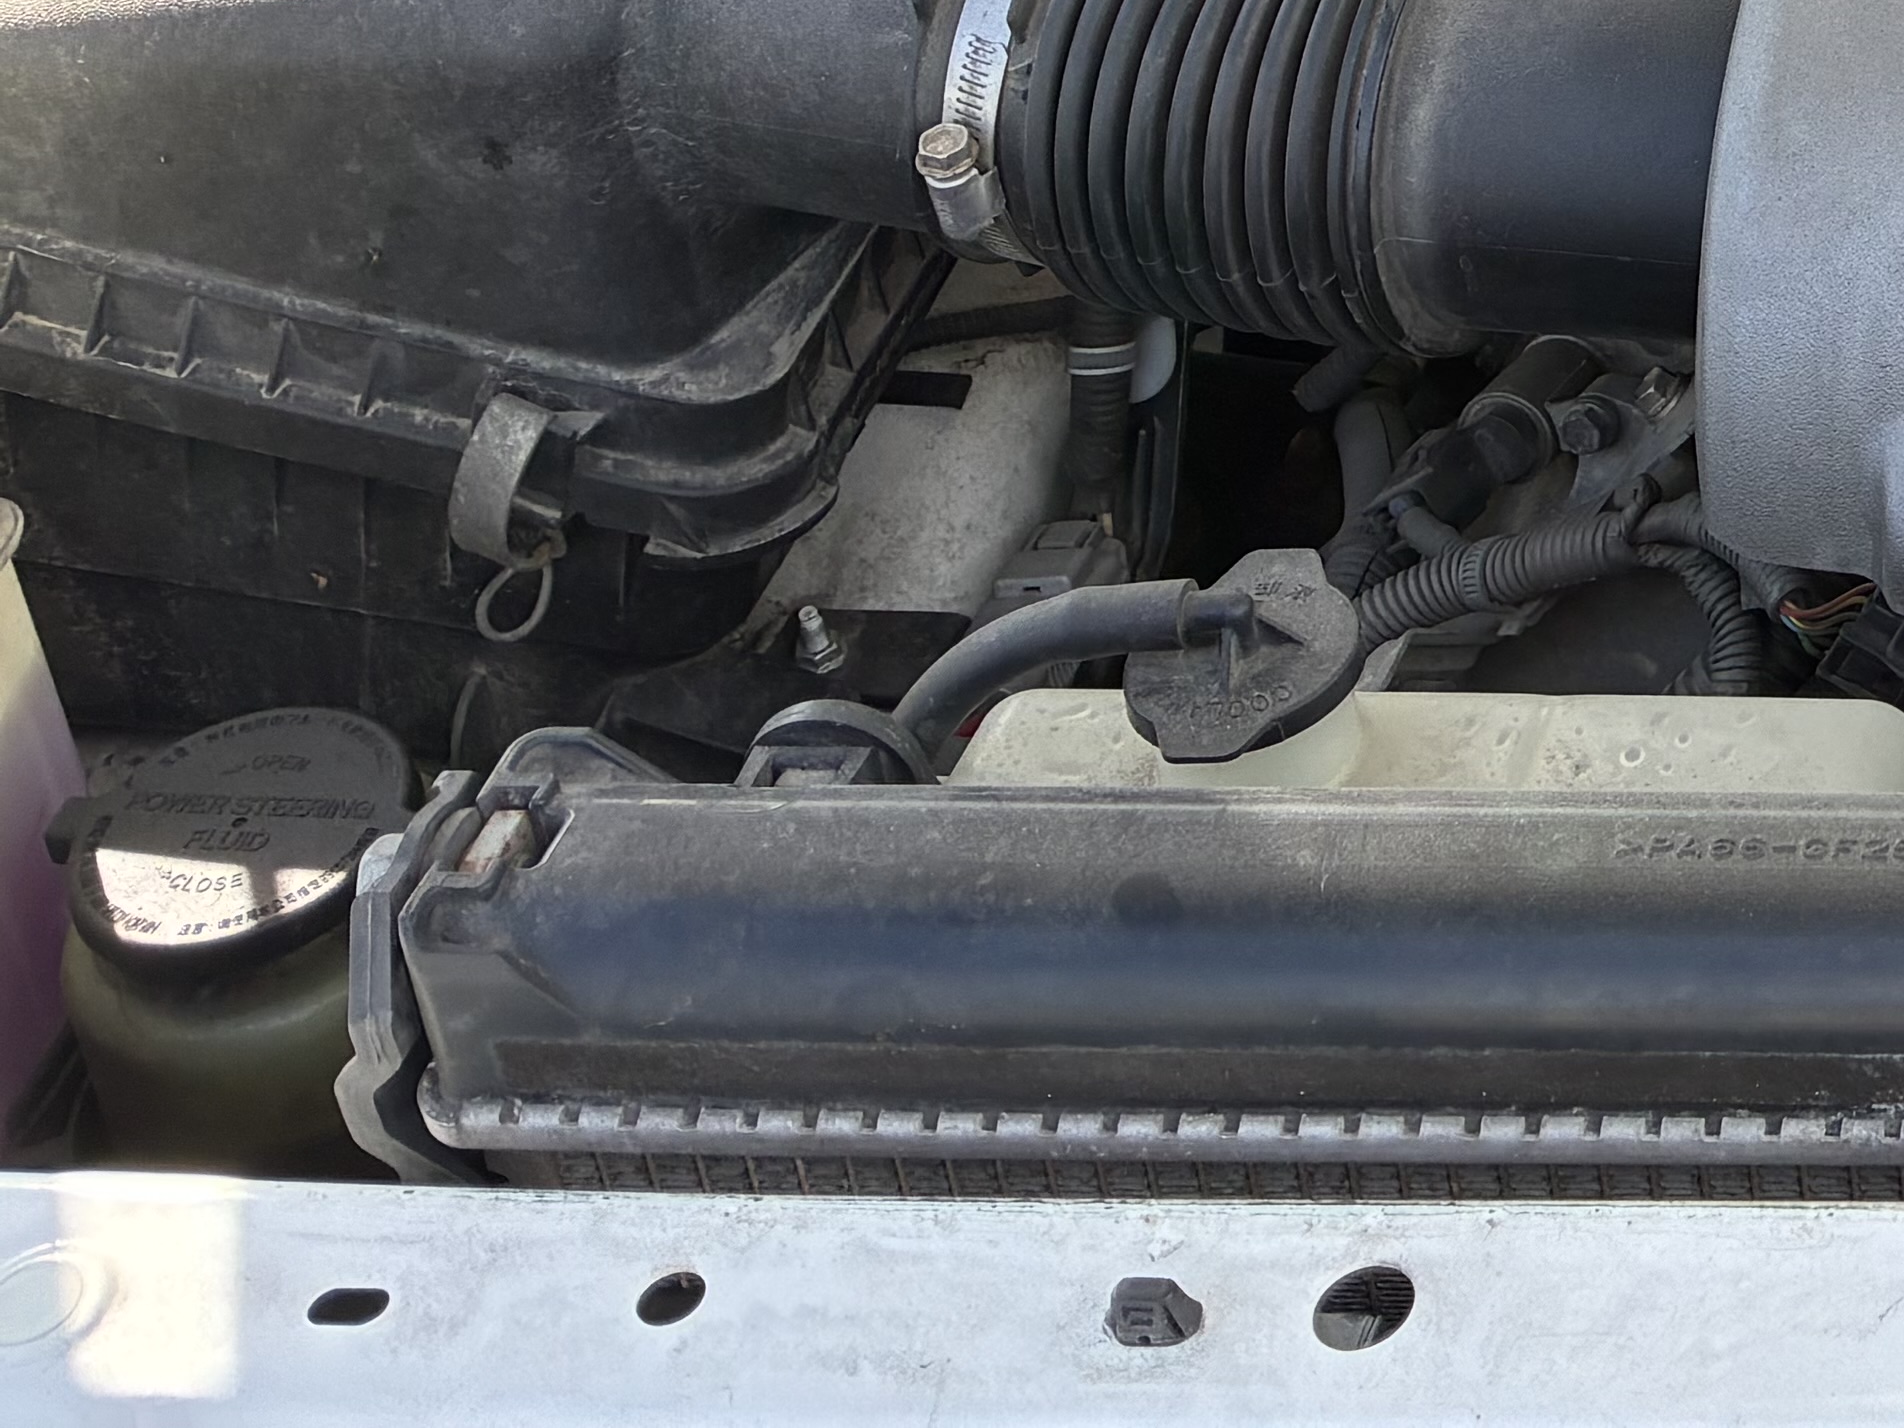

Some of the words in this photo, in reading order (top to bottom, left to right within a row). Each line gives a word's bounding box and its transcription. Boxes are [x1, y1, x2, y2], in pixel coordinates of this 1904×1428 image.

[250, 752, 313, 773] OPEN
[124, 791, 228, 816] POWER
[229, 794, 377, 820] STEERING
[182, 828, 272, 852] FLUID
[168, 872, 245, 894] CLOSE
